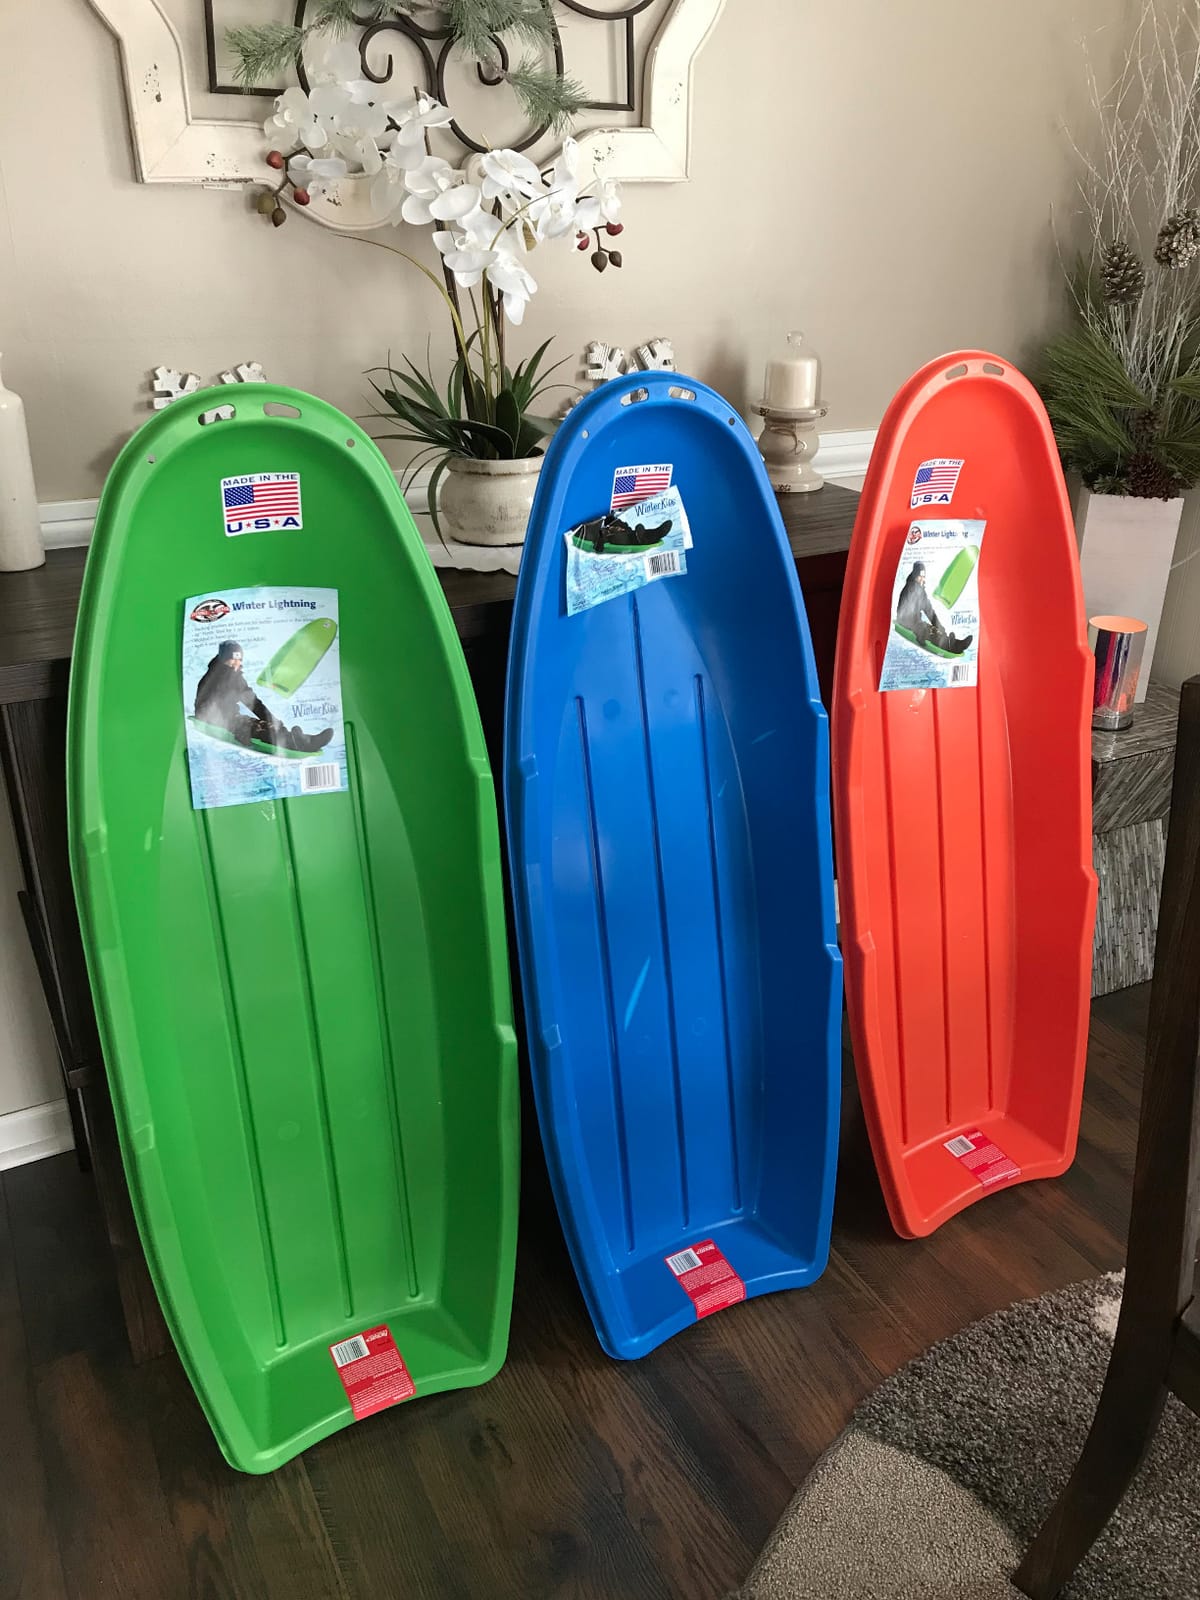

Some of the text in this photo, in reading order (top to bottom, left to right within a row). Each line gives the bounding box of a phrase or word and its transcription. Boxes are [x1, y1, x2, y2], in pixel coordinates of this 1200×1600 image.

[616, 467, 640, 475] MADE
[223, 476, 256, 487] MADE
[232, 601, 266, 611] Winter
[268, 599, 317, 610] Lightning
